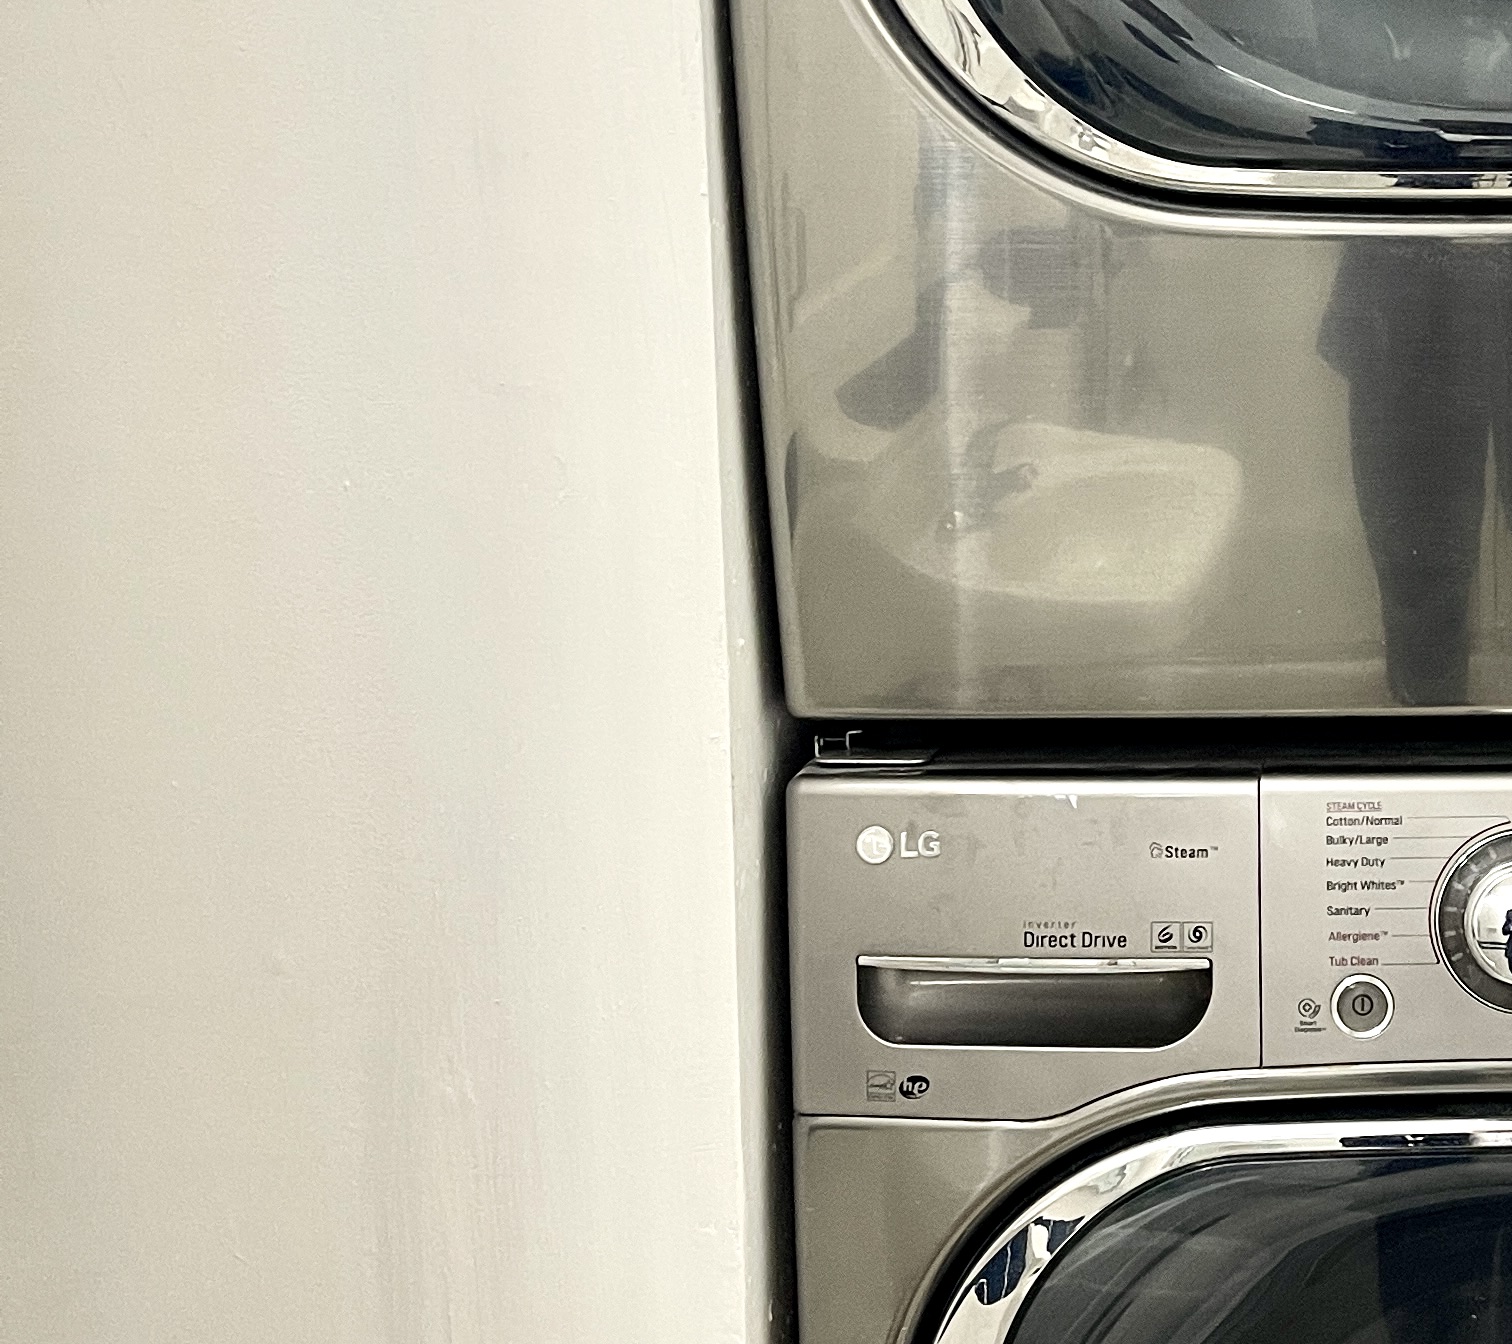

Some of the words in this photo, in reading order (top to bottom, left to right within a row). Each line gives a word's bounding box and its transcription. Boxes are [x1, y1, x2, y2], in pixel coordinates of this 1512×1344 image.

[1326, 801, 1355, 812] STEAM
[1357, 801, 1382, 811] CYCLE
[1326, 815, 1403, 826] Cotton/Normal
[900, 830, 941, 858] LG
[1326, 835, 1389, 846] Bulky/Large
[1326, 858, 1359, 868] Heavy
[1361, 856, 1386, 868] Duty
[1326, 880, 1358, 892] Bright
[1326, 905, 1371, 917] Sanitary
[1023, 931, 1077, 948] Direct
[1081, 932, 1127, 948] Drive
[1329, 956, 1348, 966] Tub
[1350, 956, 1379, 966] Clean
